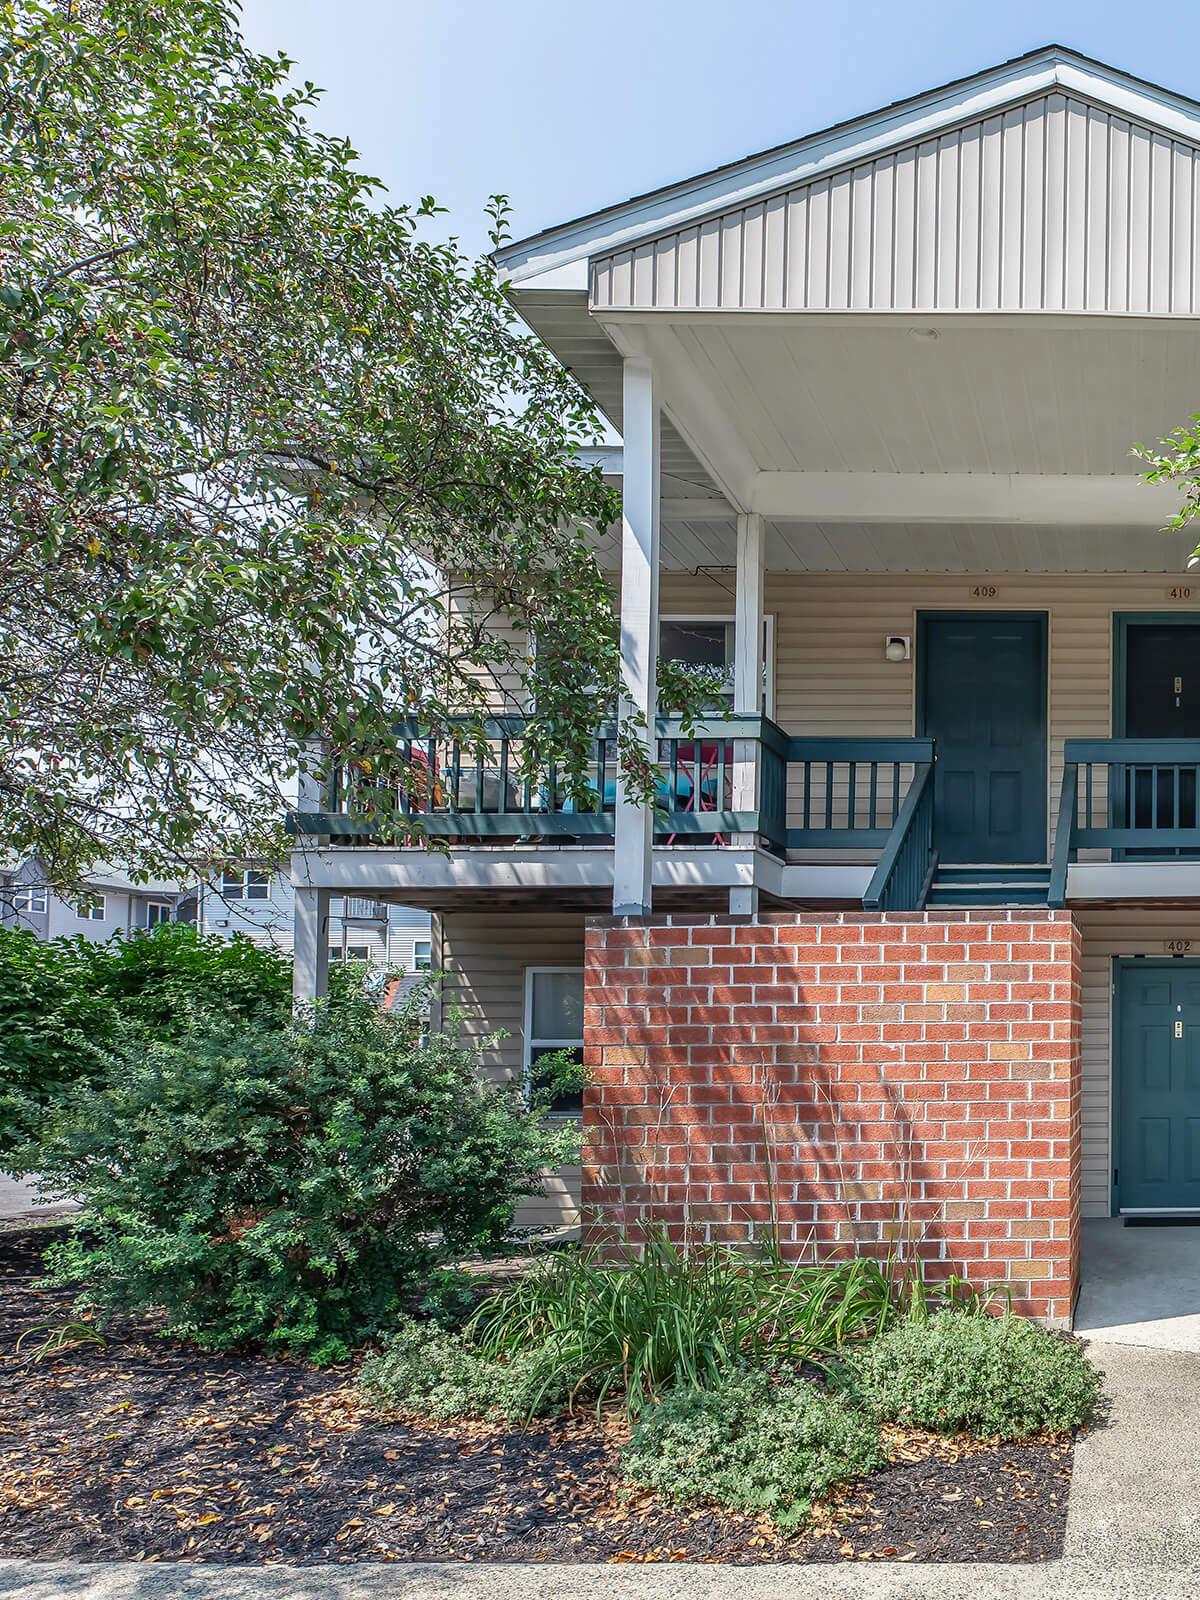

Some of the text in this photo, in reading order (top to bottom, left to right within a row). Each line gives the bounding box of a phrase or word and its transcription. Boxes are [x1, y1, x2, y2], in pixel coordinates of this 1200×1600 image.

[973, 586, 997, 597] 409
[1170, 587, 1191, 599] 410
[1168, 941, 1191, 951] 402
